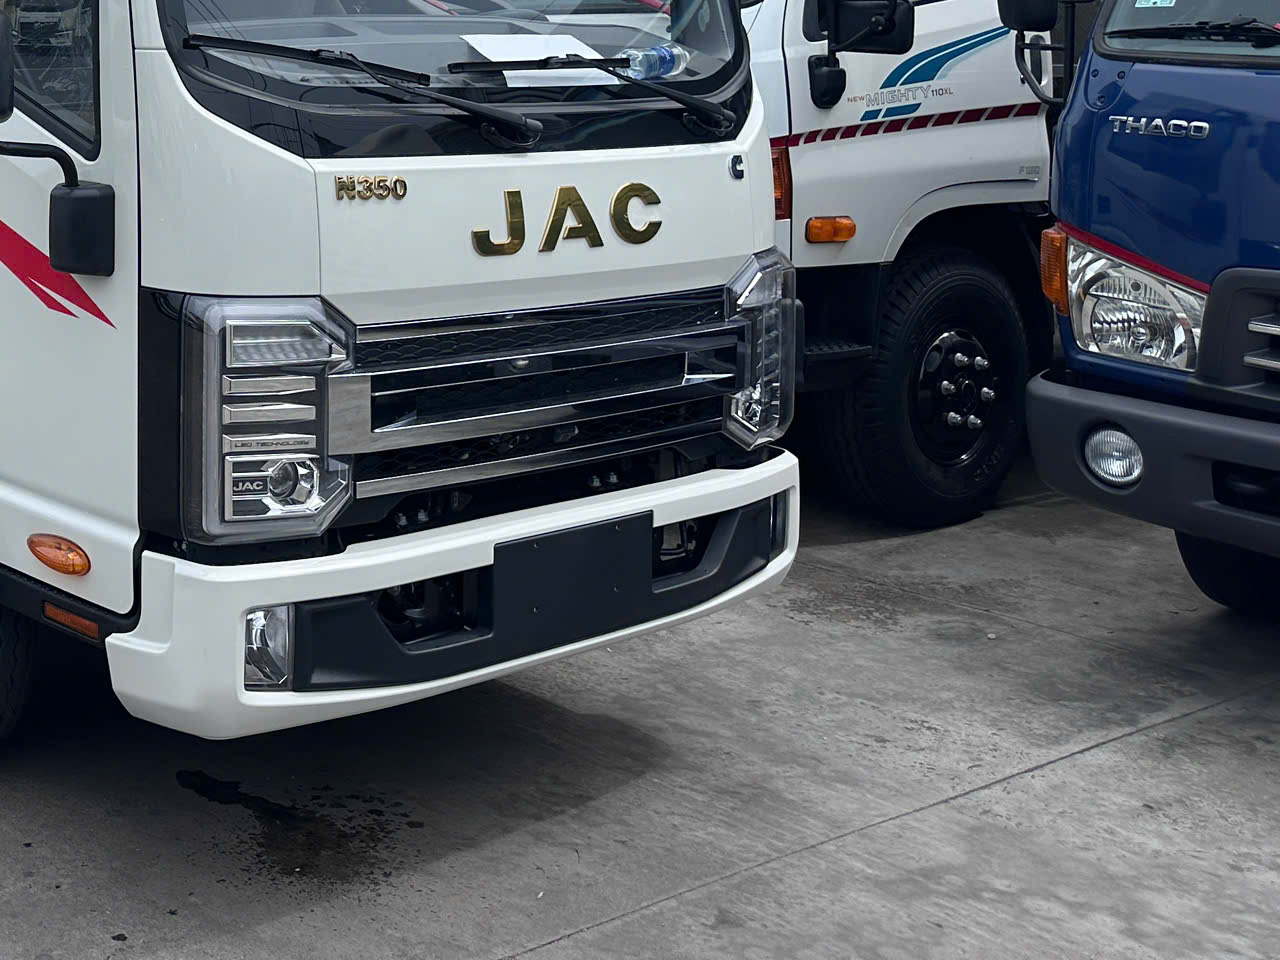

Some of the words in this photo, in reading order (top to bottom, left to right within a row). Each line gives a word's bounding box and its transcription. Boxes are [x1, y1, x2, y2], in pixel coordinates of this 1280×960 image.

[847, 95, 866, 104] NEW
[865, 85, 932, 108] MIGHTY
[931, 87, 954, 97] 110XL
[1108, 115, 1210, 140] THACO
[334, 175, 408, 201] N350
[471, 182, 663, 257] JAC
[233, 481, 264, 492] JAC
